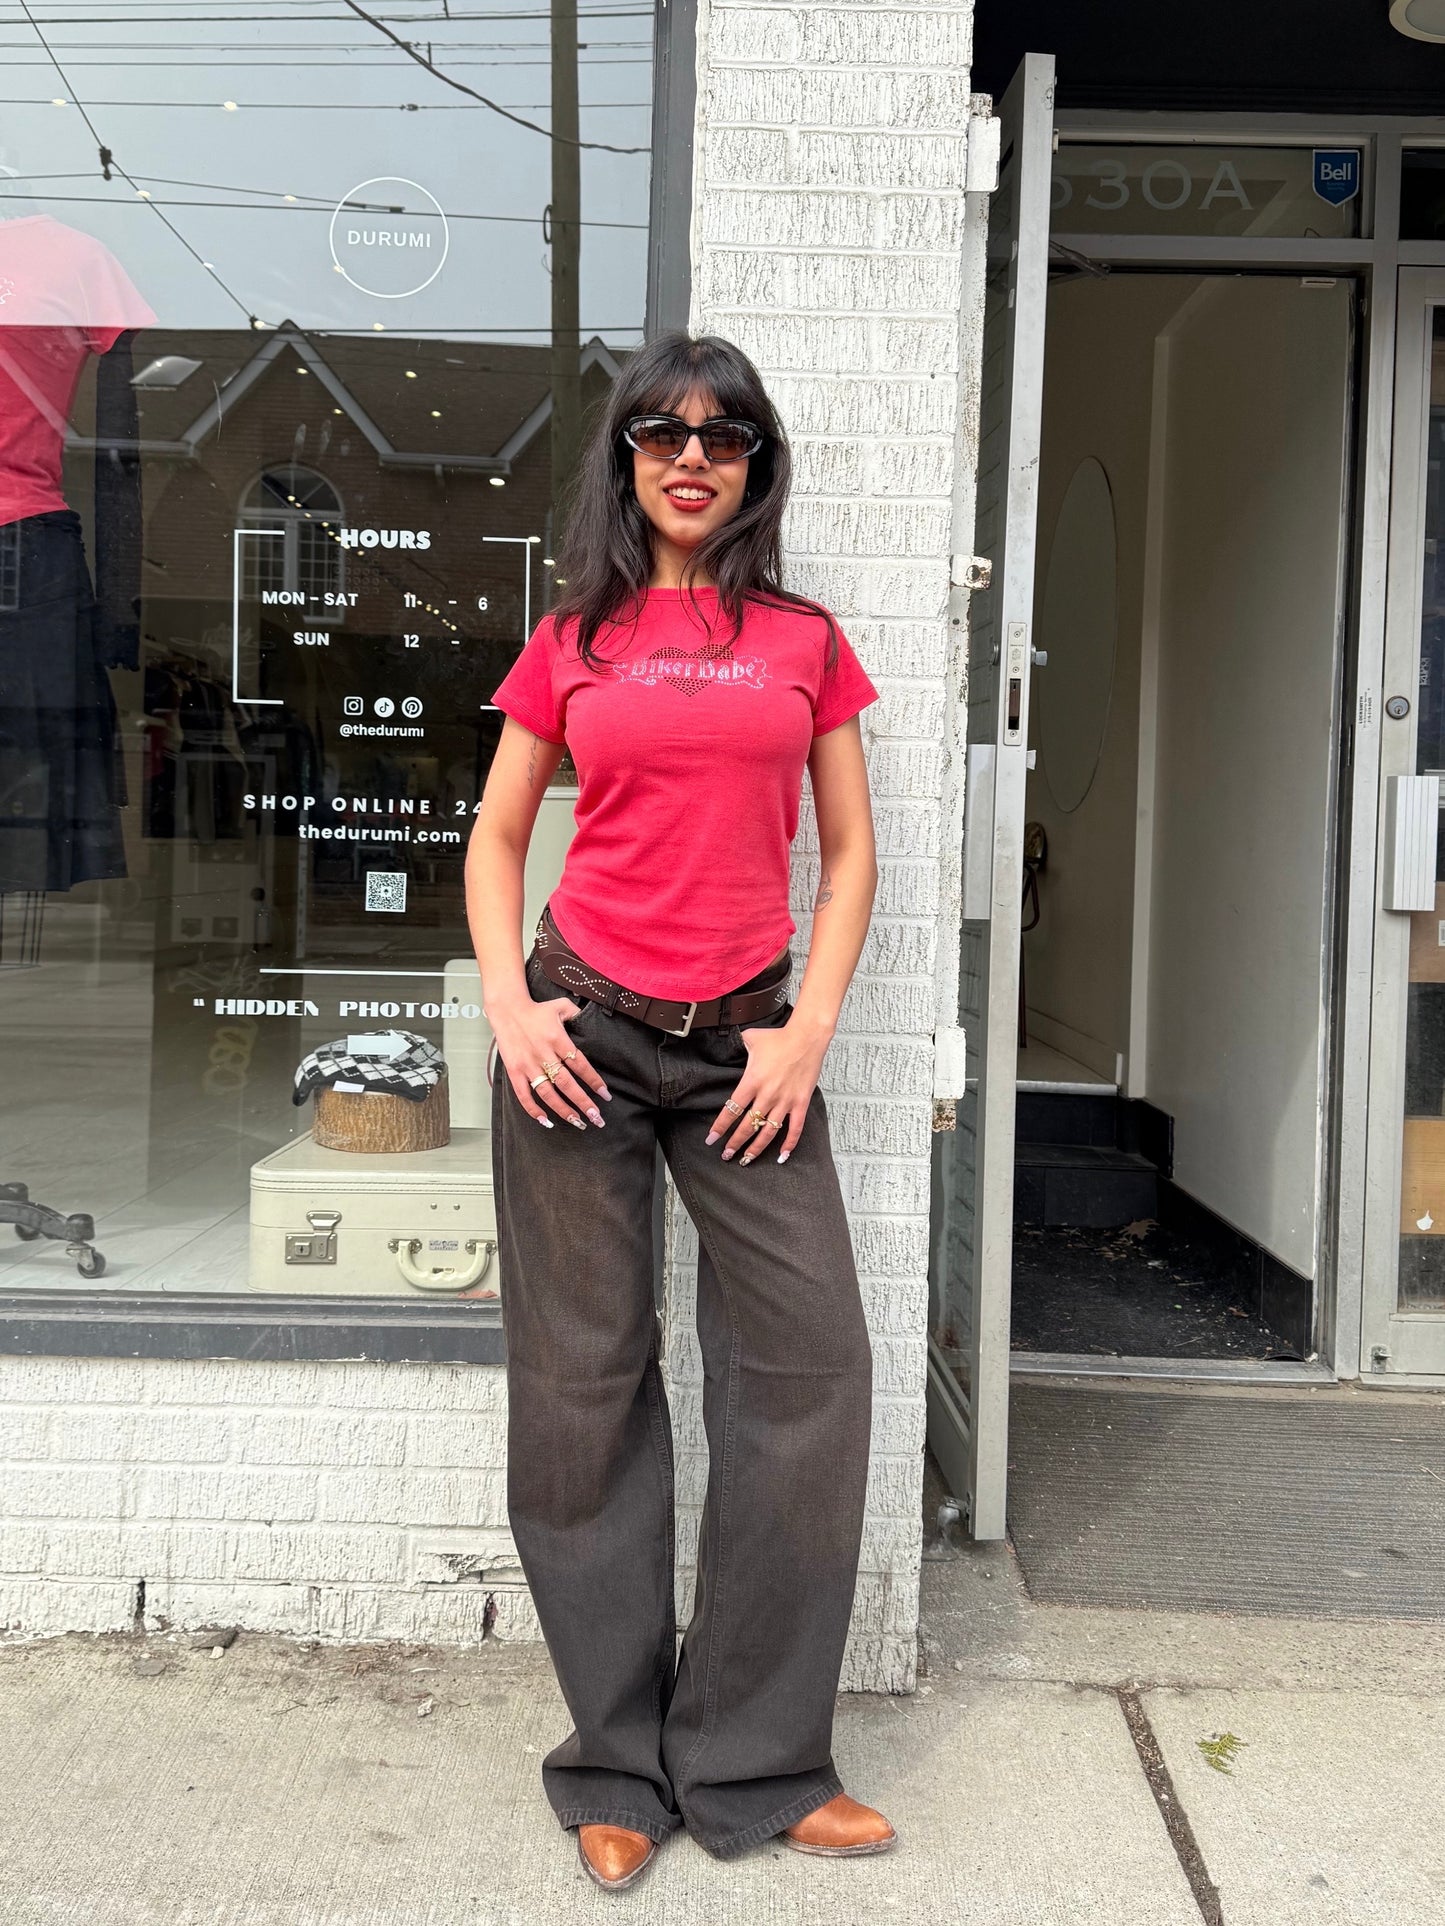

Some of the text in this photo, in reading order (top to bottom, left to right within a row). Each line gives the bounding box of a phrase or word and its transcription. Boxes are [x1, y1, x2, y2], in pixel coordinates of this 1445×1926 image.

[1320, 162, 1352, 181] Bell
[347, 230, 431, 248] DURUMI
[340, 529, 431, 550] HOURS
[262, 590, 305, 605] MON
[324, 592, 359, 607] SAT
[478, 596, 488, 611] 6
[293, 631, 330, 646] SUN
[403, 634, 420, 648] 12
[339, 723, 424, 738] @thedurumi
[243, 794, 316, 811] SHOP
[331, 797, 430, 815] ONLINE
[298, 824, 461, 844] thedurumi.com
[214, 998, 320, 1017] HIDDEN
[339, 1001, 487, 1019] PHOTOBO
